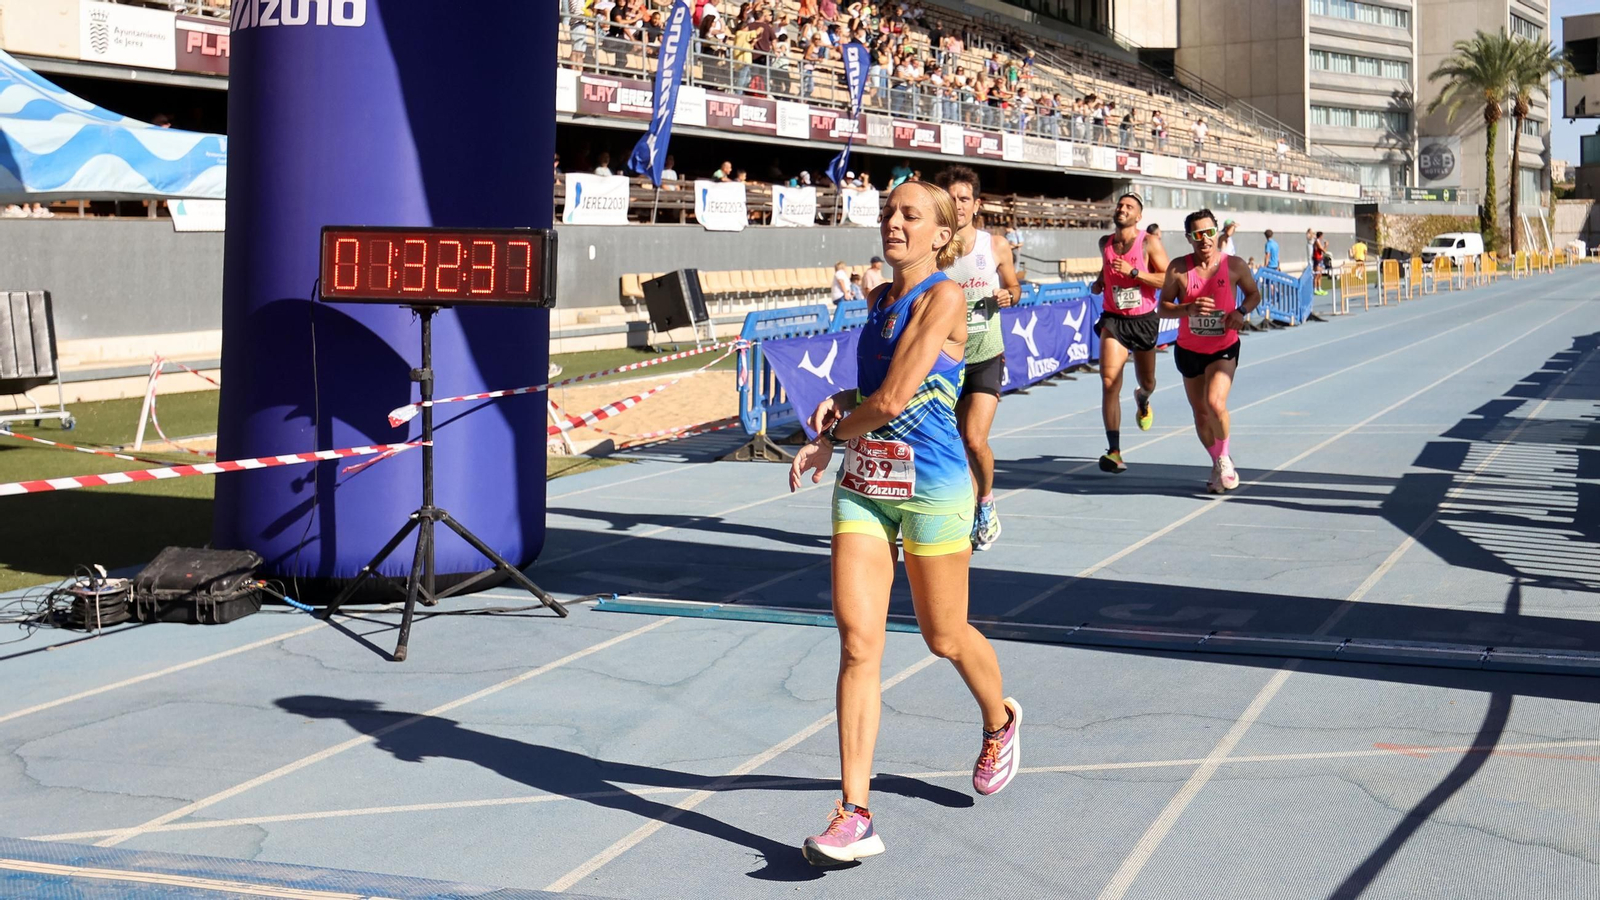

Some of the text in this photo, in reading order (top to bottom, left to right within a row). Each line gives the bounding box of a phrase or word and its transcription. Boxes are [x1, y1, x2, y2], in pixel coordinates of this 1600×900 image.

[114, 26, 166, 41] Ayuntamiento
[125, 37, 144, 47] Jerez
[187, 31, 230, 58] PLA
[584, 83, 615, 103] PLAY
[608, 87, 653, 112] JEREZ
[709, 101, 738, 117] PLAY
[732, 104, 768, 127] JEREZ
[811, 115, 834, 130] PLAY
[895, 126, 914, 140] PLAY
[964, 136, 981, 148] PLAY
[1420, 153, 1453, 168] B&B
[582, 196, 627, 211] JEREZ2031
[706, 200, 744, 213] JEREZ203
[334, 238, 532, 294] 01:32:37
[1122, 291, 1135, 300] 20
[1197, 318, 1217, 328] 109
[856, 455, 893, 479] 299
